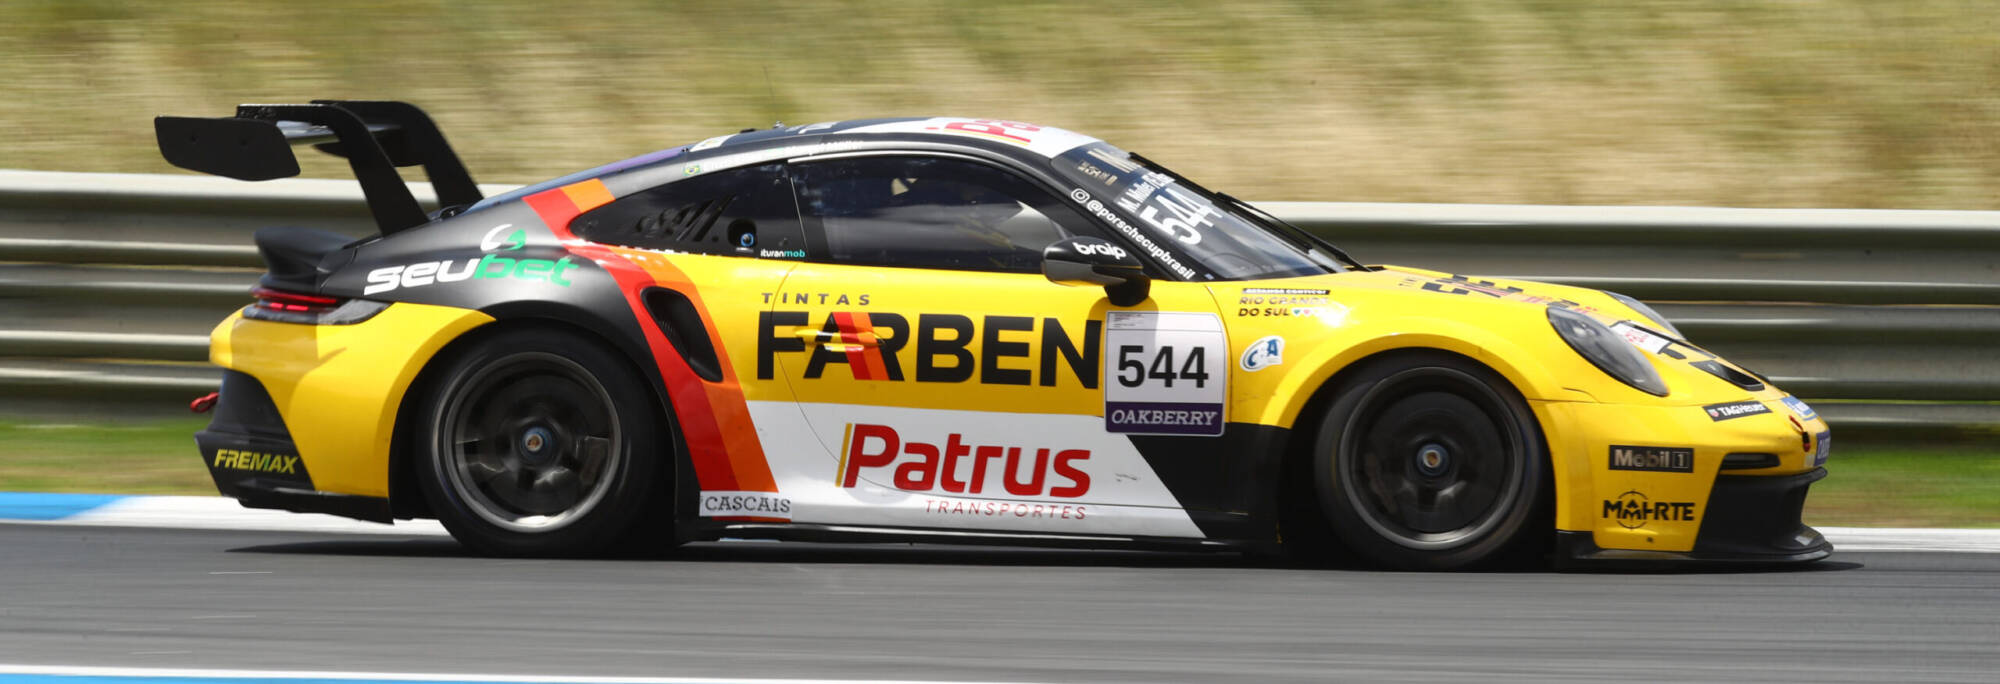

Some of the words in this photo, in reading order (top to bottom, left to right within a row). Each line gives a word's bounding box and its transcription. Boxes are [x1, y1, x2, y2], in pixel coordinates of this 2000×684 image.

[1139, 188, 1222, 245] 544
[1087, 200, 1195, 279] @porschecupbrasil
[760, 249, 806, 257] ituranmob
[364, 254, 579, 295] seubet
[761, 292, 870, 305] TINTAS
[1239, 308, 1260, 316] DO
[1264, 308, 1289, 316] SUL
[757, 311, 1102, 389] FARBEN
[1117, 345, 1209, 388] 544
[1111, 409, 1218, 426] OAKBERRY
[214, 449, 298, 473] FREMAX
[843, 424, 1091, 498] Patrus
[1614, 449, 1670, 467] Mobil
[705, 496, 791, 513] CASCAIS
[926, 499, 1087, 520] TRANSPORTES
